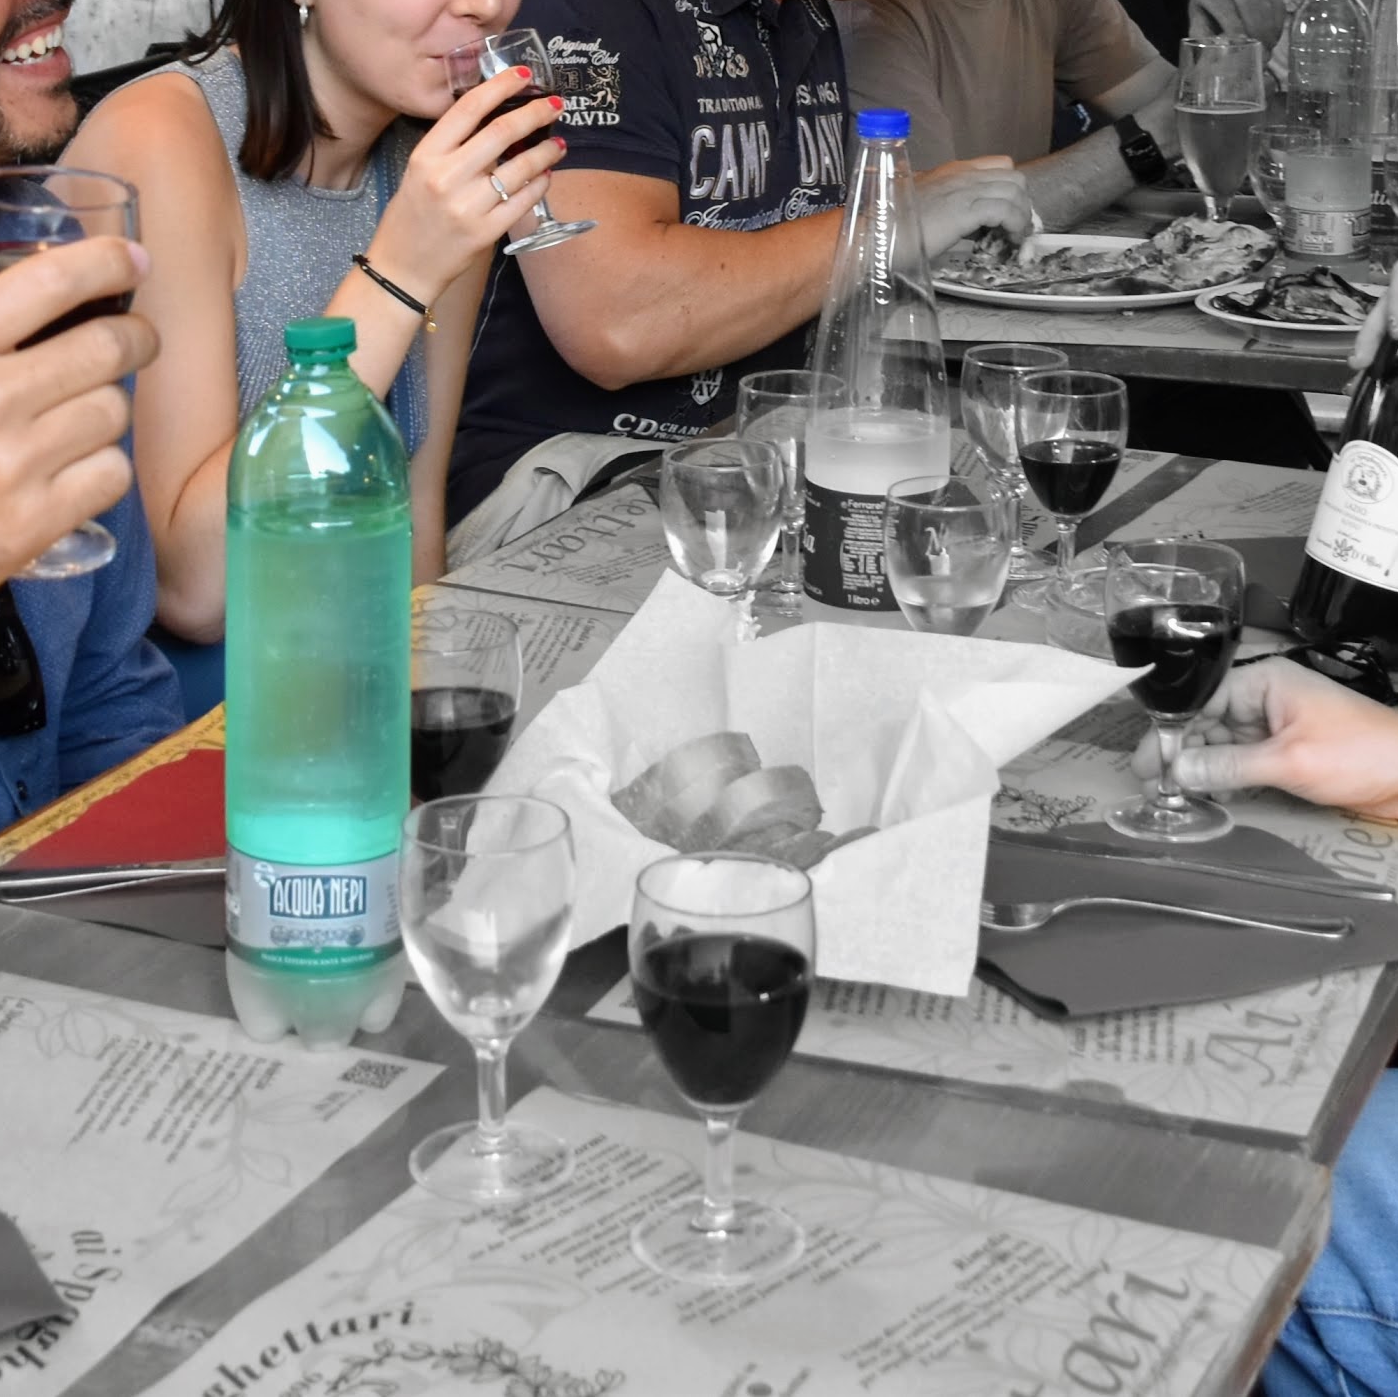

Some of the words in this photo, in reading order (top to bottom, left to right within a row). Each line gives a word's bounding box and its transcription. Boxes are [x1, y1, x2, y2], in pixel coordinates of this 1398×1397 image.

[547, 35, 602, 56] Original
[589, 51, 620, 66] Club
[559, 110, 620, 126] DAVID
[689, 122, 772, 201] CAMP
[273, 877, 324, 917] ACQUA
[330, 877, 364, 915] NEPI
